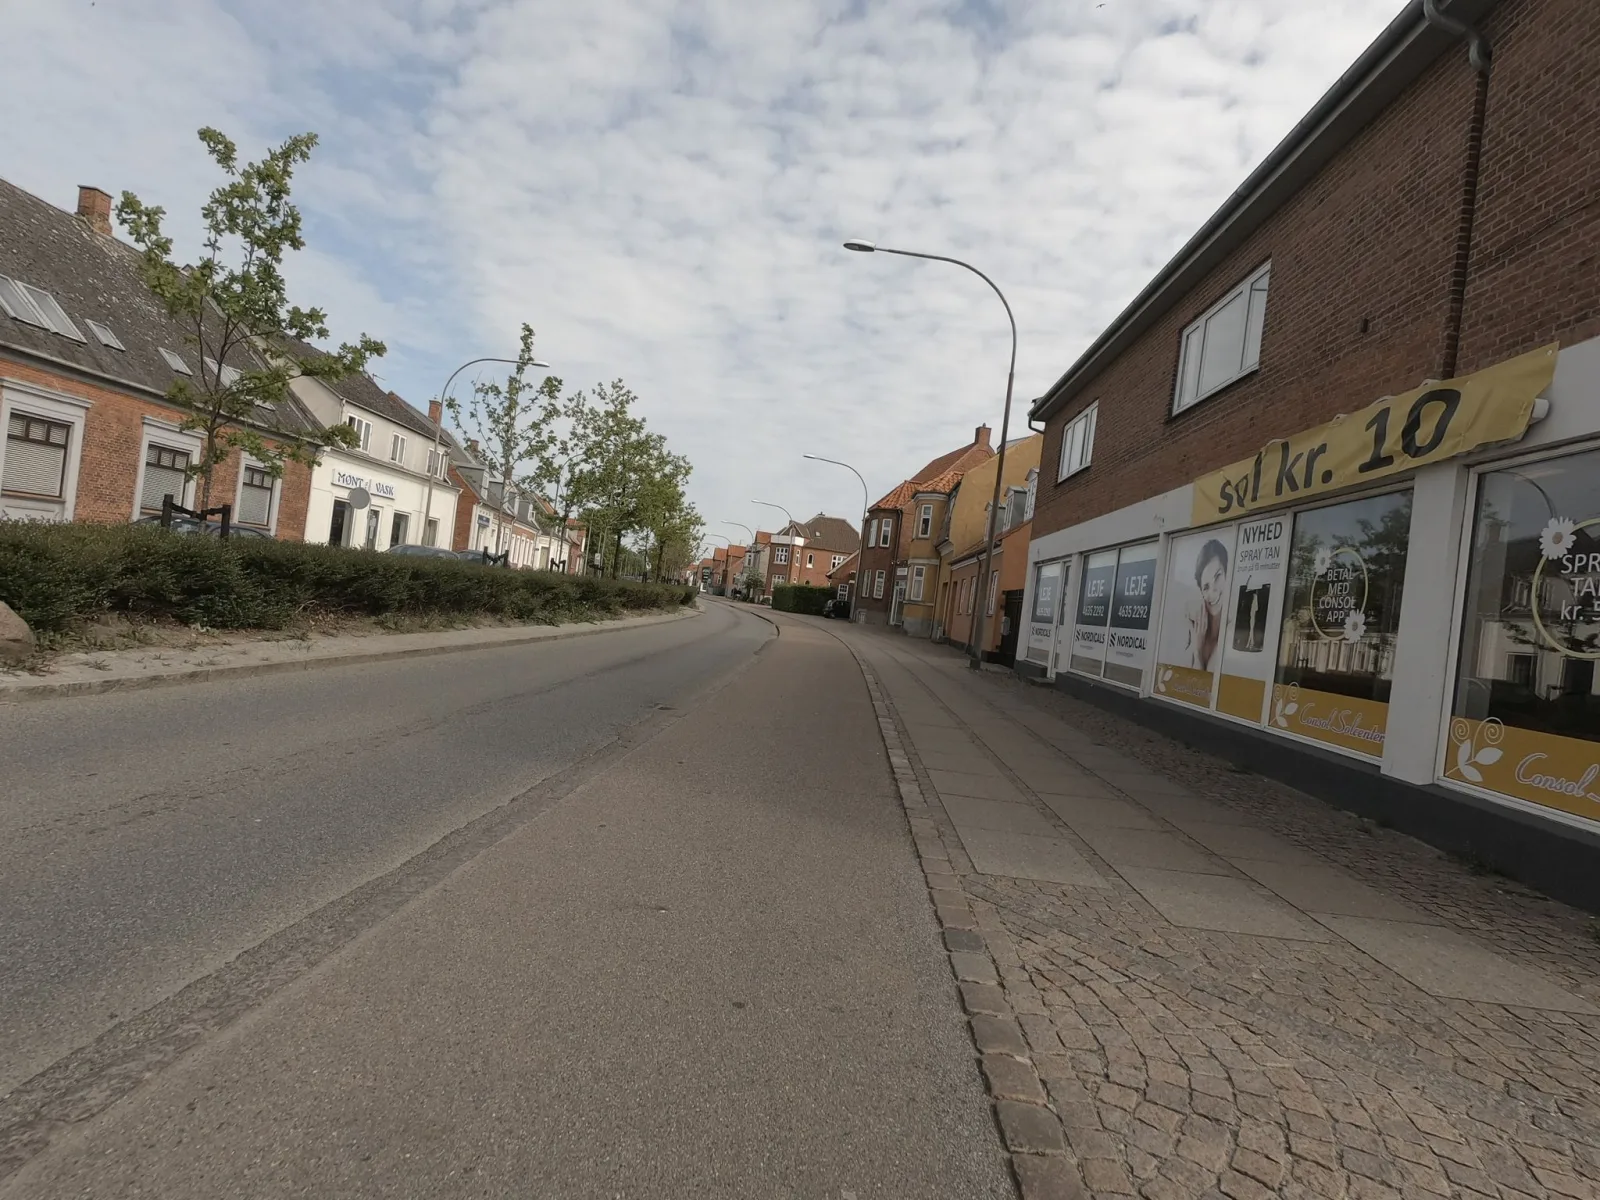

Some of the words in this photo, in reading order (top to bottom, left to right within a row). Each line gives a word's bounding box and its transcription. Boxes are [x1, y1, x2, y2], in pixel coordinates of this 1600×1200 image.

[1275, 441, 1333, 496] kr.
[1358, 388, 1462, 473] 10
[375, 482, 394, 496] VASK
[1242, 521, 1283, 544] NYHED
[1240, 548, 1263, 562] SPRAY
[1264, 546, 1280, 559] TAN
[1327, 568, 1354, 581] BETAL
[1087, 579, 1105, 597] LEJE
[1124, 574, 1148, 596] LEJE
[1328, 582, 1350, 596] MED
[1570, 576, 1600, 597] TA
[1319, 596, 1356, 609] CONSOL
[1561, 600, 1584, 620] kr.
[1093, 605, 1105, 617] 2292
[1118, 605, 1133, 618] 4635
[1132, 605, 1148, 618] 2292
[1326, 610, 1345, 622] APP
[1081, 631, 1106, 644] NORDICALS
[1117, 635, 1148, 650] NORDICAL
[1299, 702, 1338, 730] Consol
[1331, 709, 1386, 743] Solcenter
[1515, 752, 1600, 797] Consol
